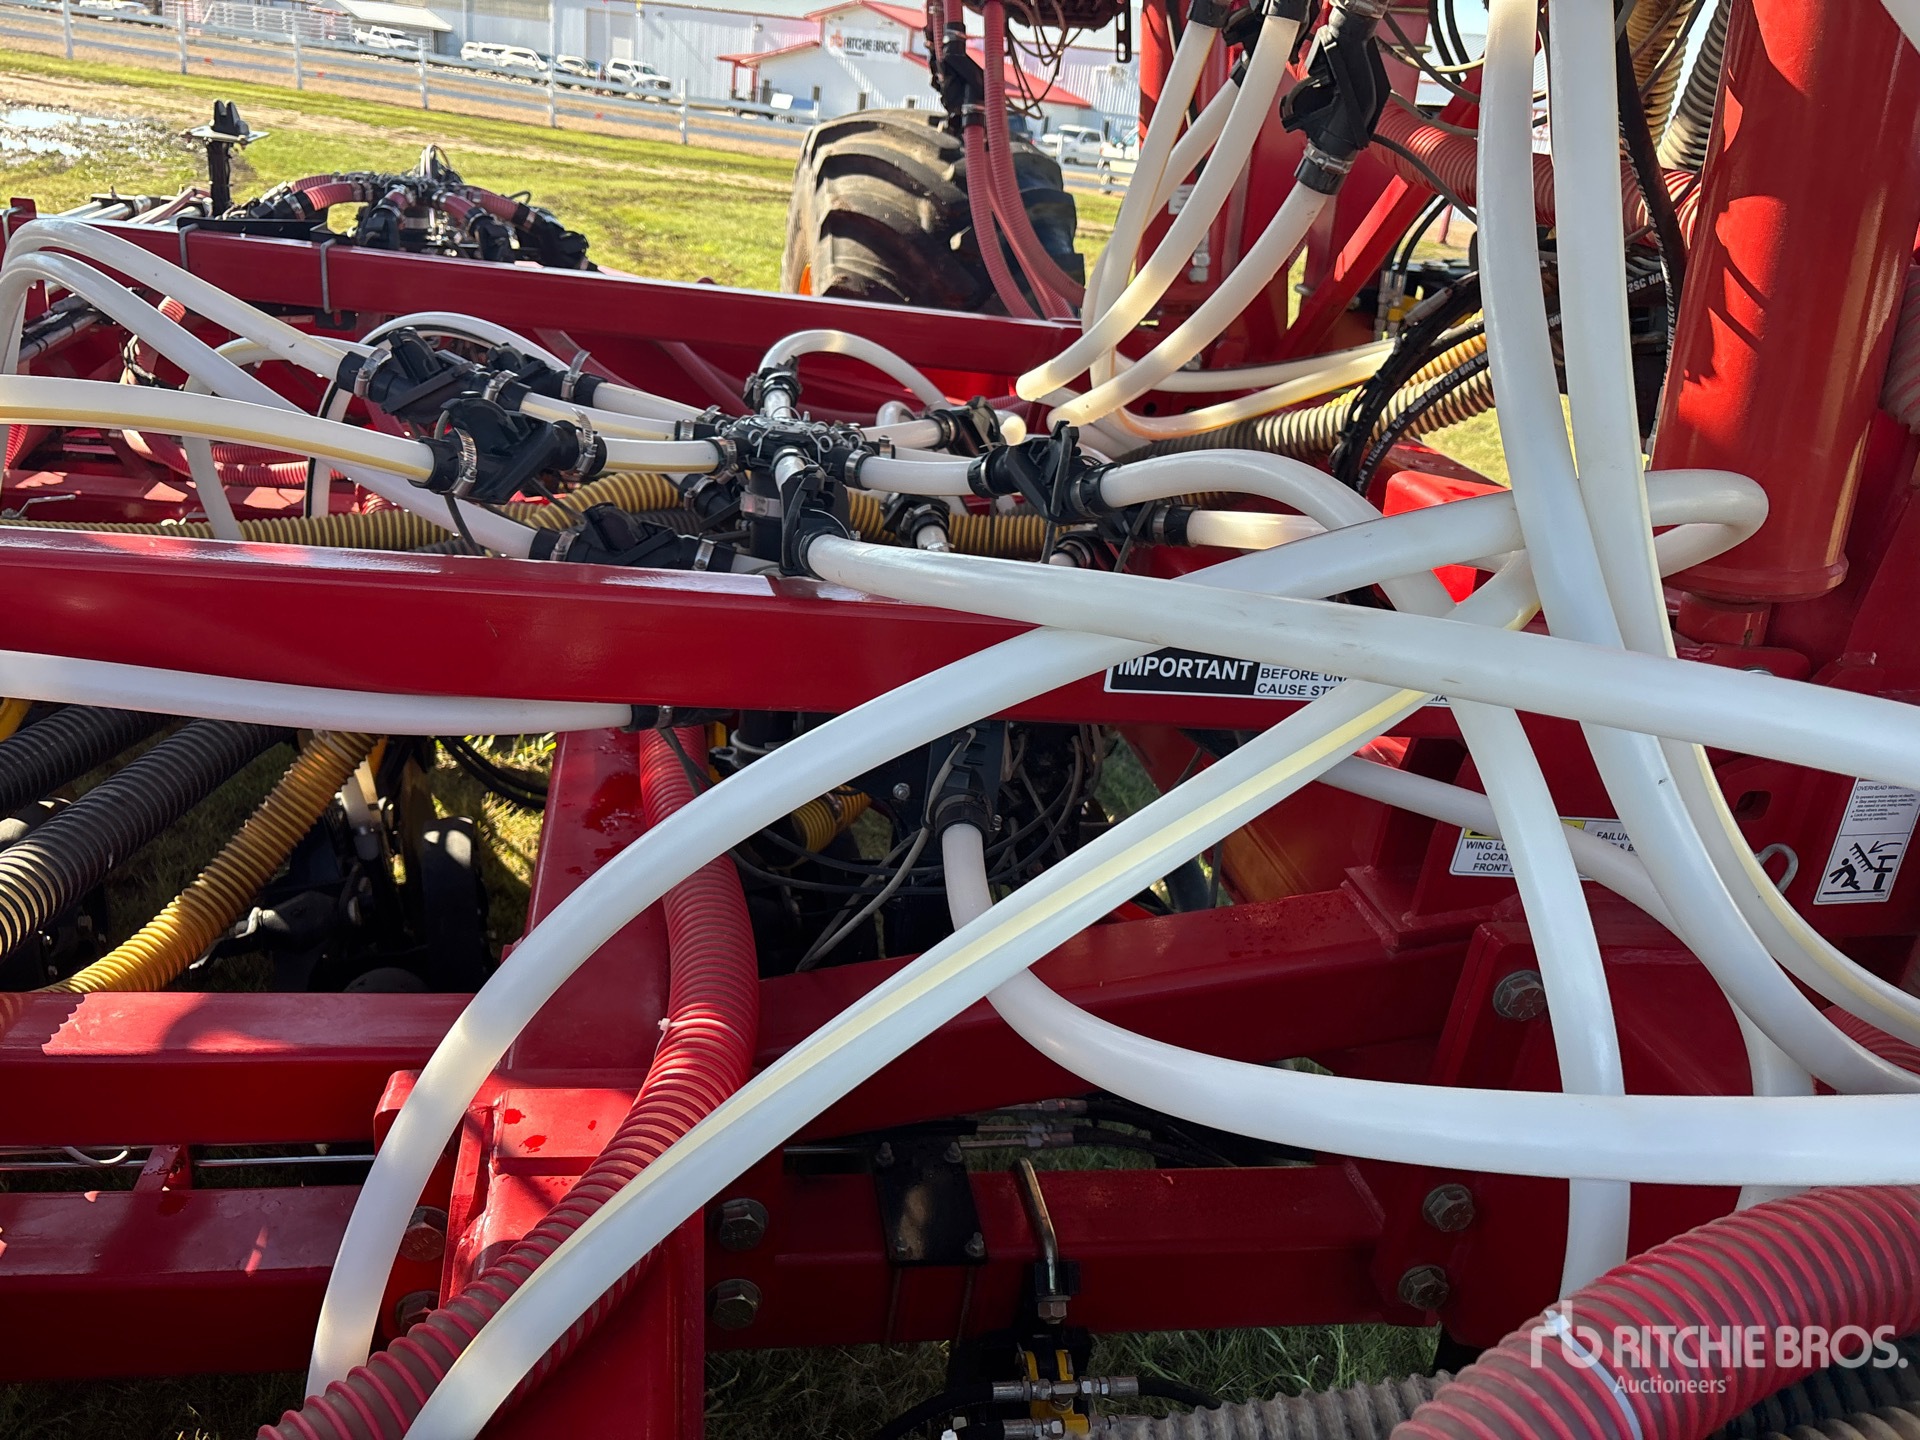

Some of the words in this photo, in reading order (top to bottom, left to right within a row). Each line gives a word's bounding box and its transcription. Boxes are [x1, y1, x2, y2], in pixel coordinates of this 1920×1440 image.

[1459, 360, 1476, 376] BAR
[1117, 656, 1253, 681] IMPORTANT
[1260, 668, 1319, 681] BEFORE
[1257, 683, 1307, 696] CAUSE
[1466, 841, 1493, 850] WING
[1472, 862, 1508, 872] FRONT
